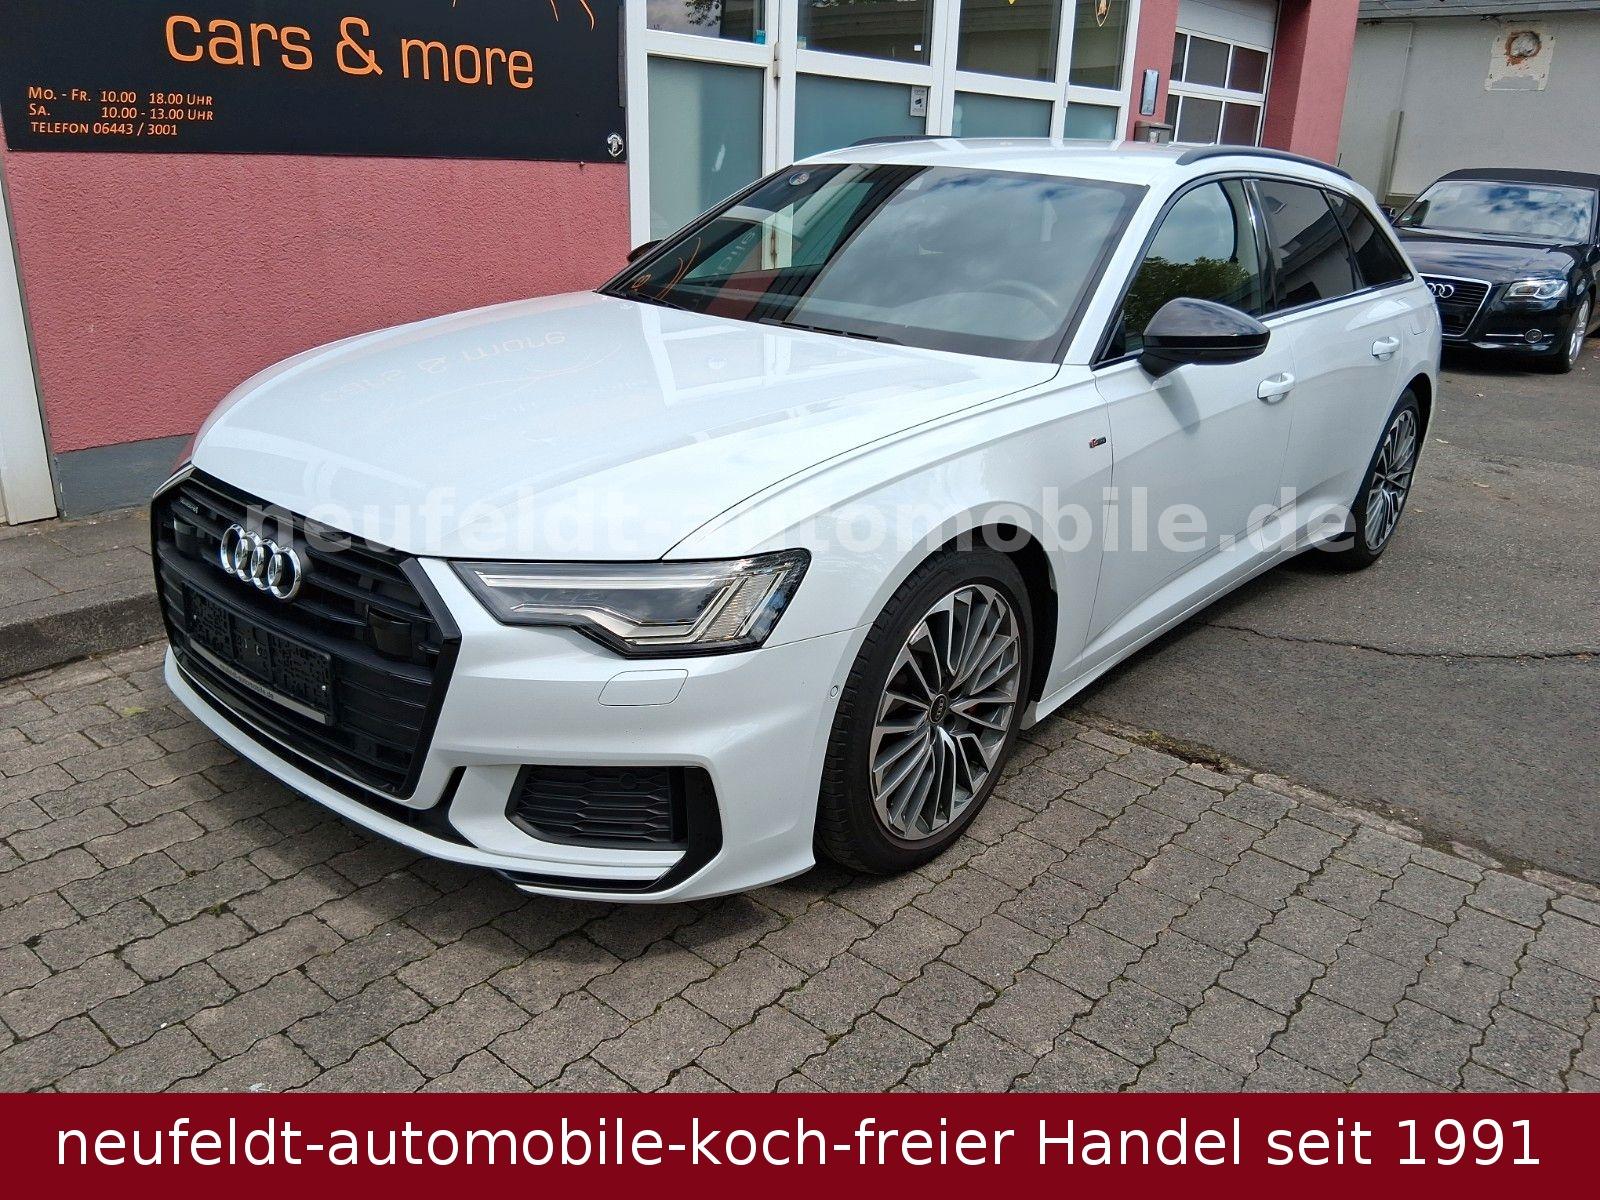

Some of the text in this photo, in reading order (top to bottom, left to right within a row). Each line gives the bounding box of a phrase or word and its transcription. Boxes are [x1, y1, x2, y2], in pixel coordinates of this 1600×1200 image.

[165, 14, 534, 89] cars & more
[28, 87, 57, 101] MO.
[71, 89, 91, 102] FR.
[101, 91, 137, 103] 10.00
[149, 93, 183, 105] 18.00
[187, 94, 213, 106] UHR
[29, 103, 51, 116] SA.
[101, 107, 138, 119] 10.00
[150, 108, 184, 120] 13.00
[187, 110, 214, 121] UHR
[31, 122, 89, 134] TELEFON
[92, 123, 134, 135] 06443
[147, 124, 178, 136] 3001
